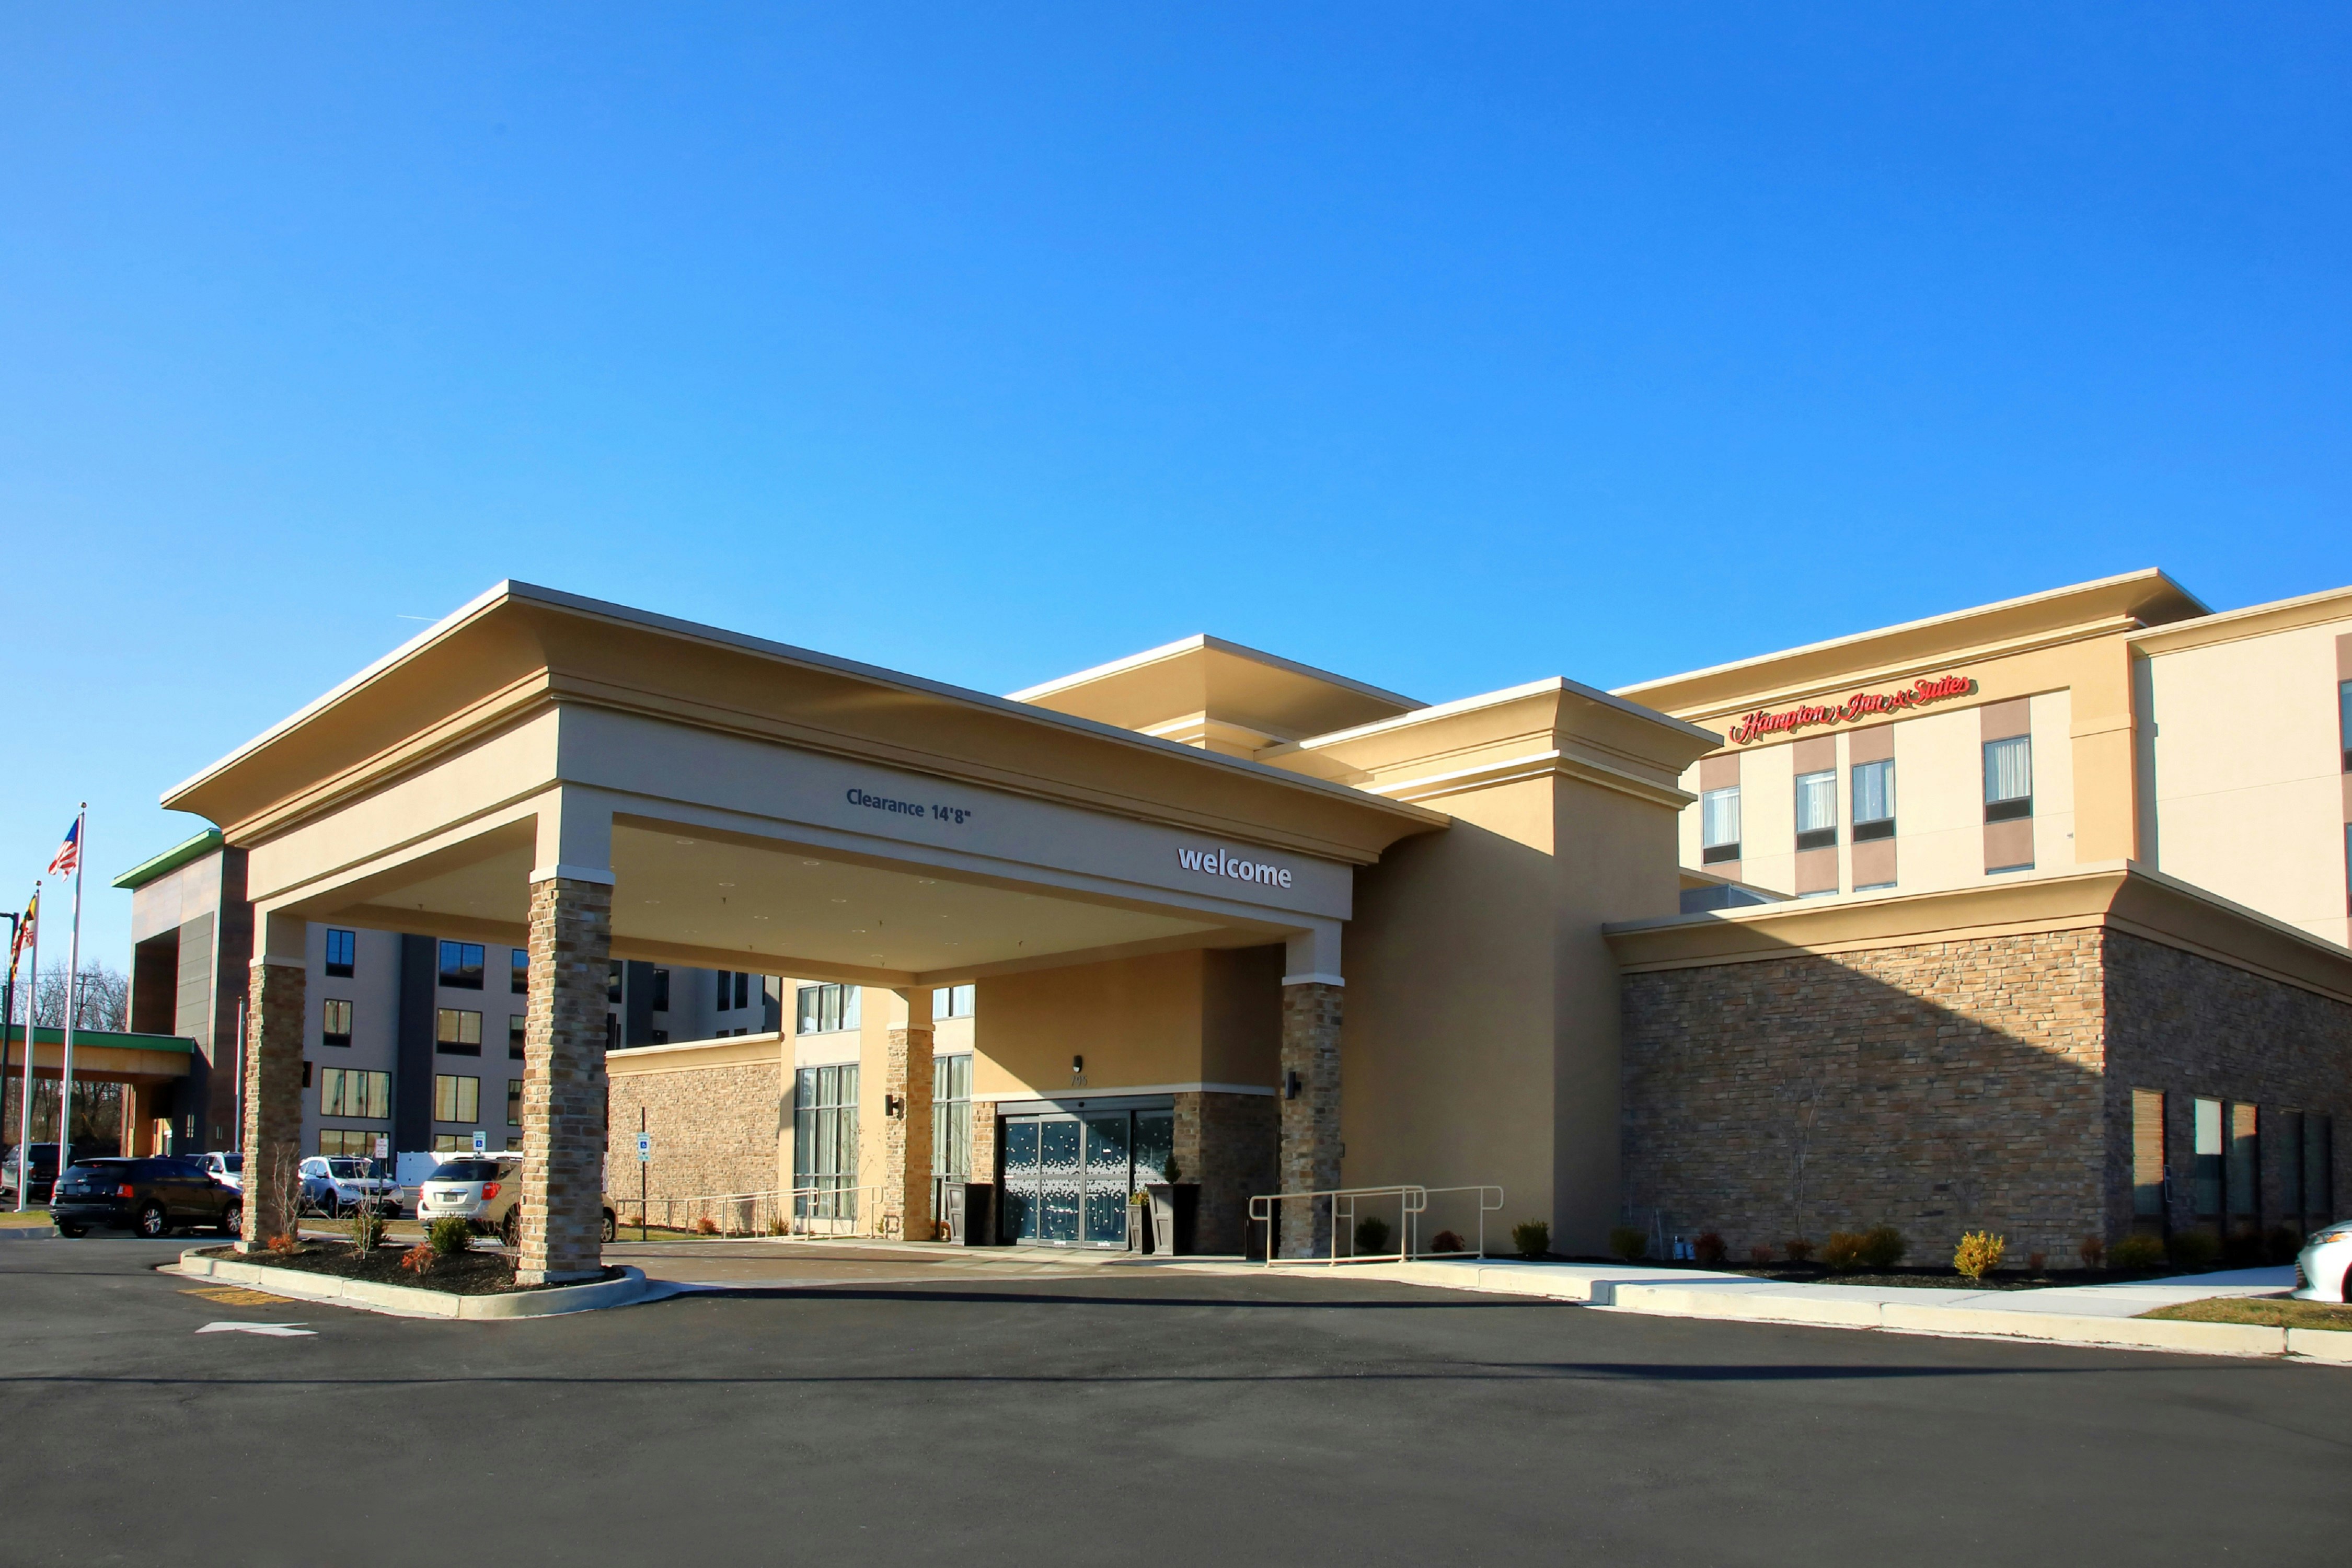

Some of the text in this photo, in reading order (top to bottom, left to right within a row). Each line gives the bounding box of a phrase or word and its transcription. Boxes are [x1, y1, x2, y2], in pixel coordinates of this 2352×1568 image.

[1729, 674, 1970, 742] Hampton Inn & Suites
[846, 788, 972, 824] Clearance 14'8"
[1178, 848, 1293, 889] welcome
